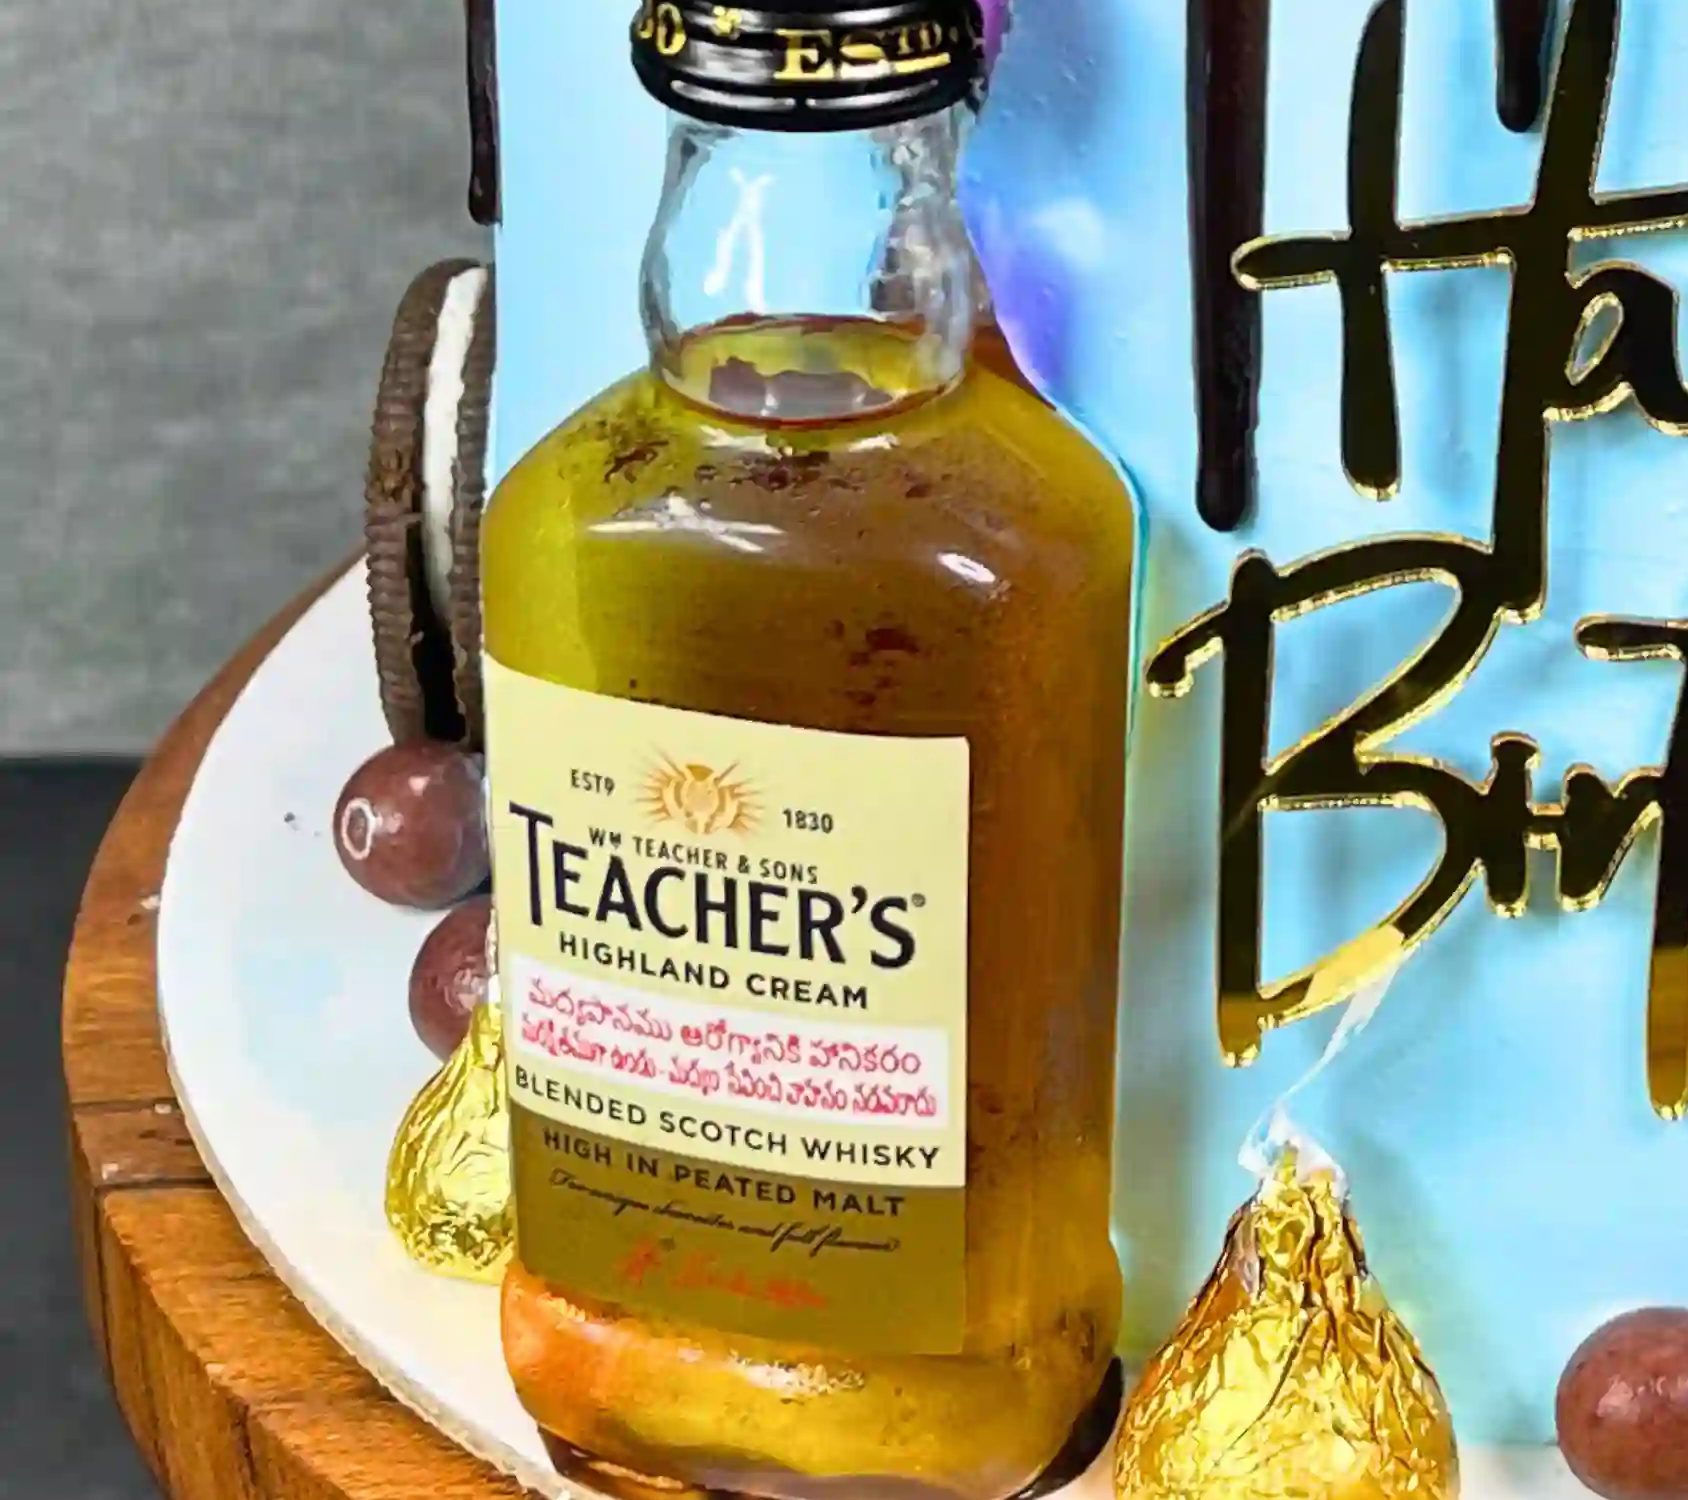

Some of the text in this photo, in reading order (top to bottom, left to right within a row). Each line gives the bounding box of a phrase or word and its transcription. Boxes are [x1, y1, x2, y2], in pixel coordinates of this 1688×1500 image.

[632, 835, 728, 871] TEACHER
[737, 854, 750, 875] &
[759, 858, 818, 885] SONS
[782, 808, 834, 834] 1830
[559, 930, 869, 1010] HIGHLAND CREAM
[515, 1064, 940, 1170] BLENDED SCOTCH WHISKY
[543, 1125, 907, 1218] HIGH IN PEATED MALT
